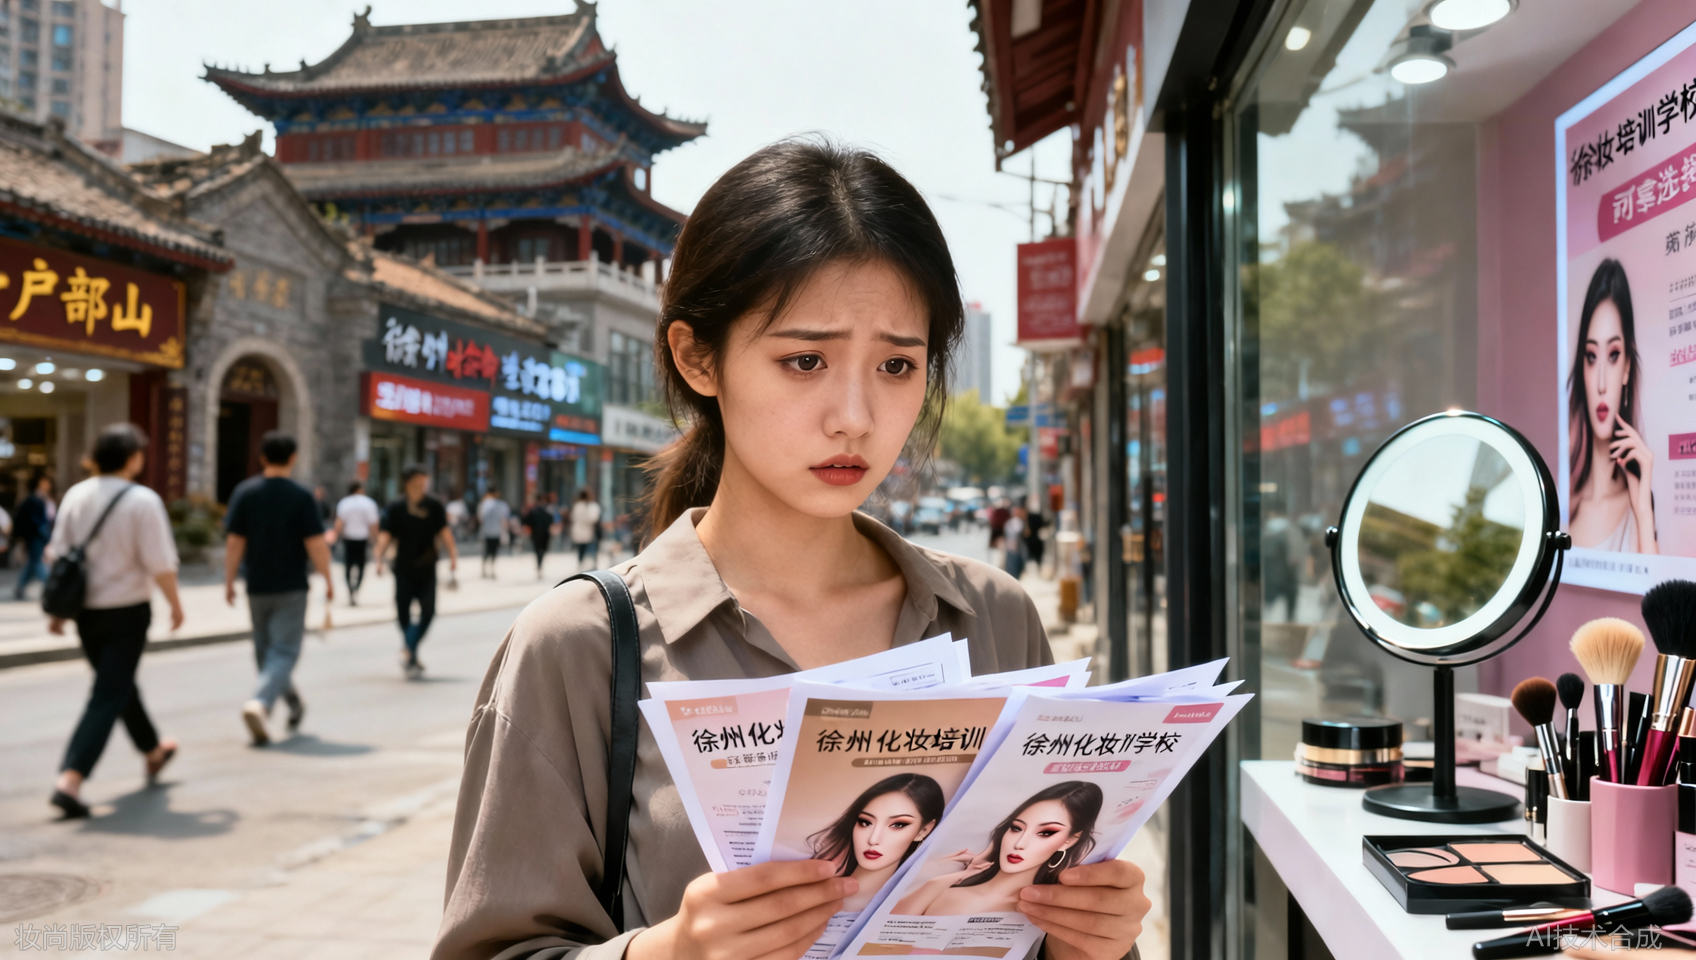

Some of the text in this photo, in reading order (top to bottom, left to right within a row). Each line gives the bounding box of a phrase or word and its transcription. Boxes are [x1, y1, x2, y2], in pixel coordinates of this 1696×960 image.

[0, 257, 153, 339] 户部山
[816, 726, 987, 753] 徐州化妆培训
